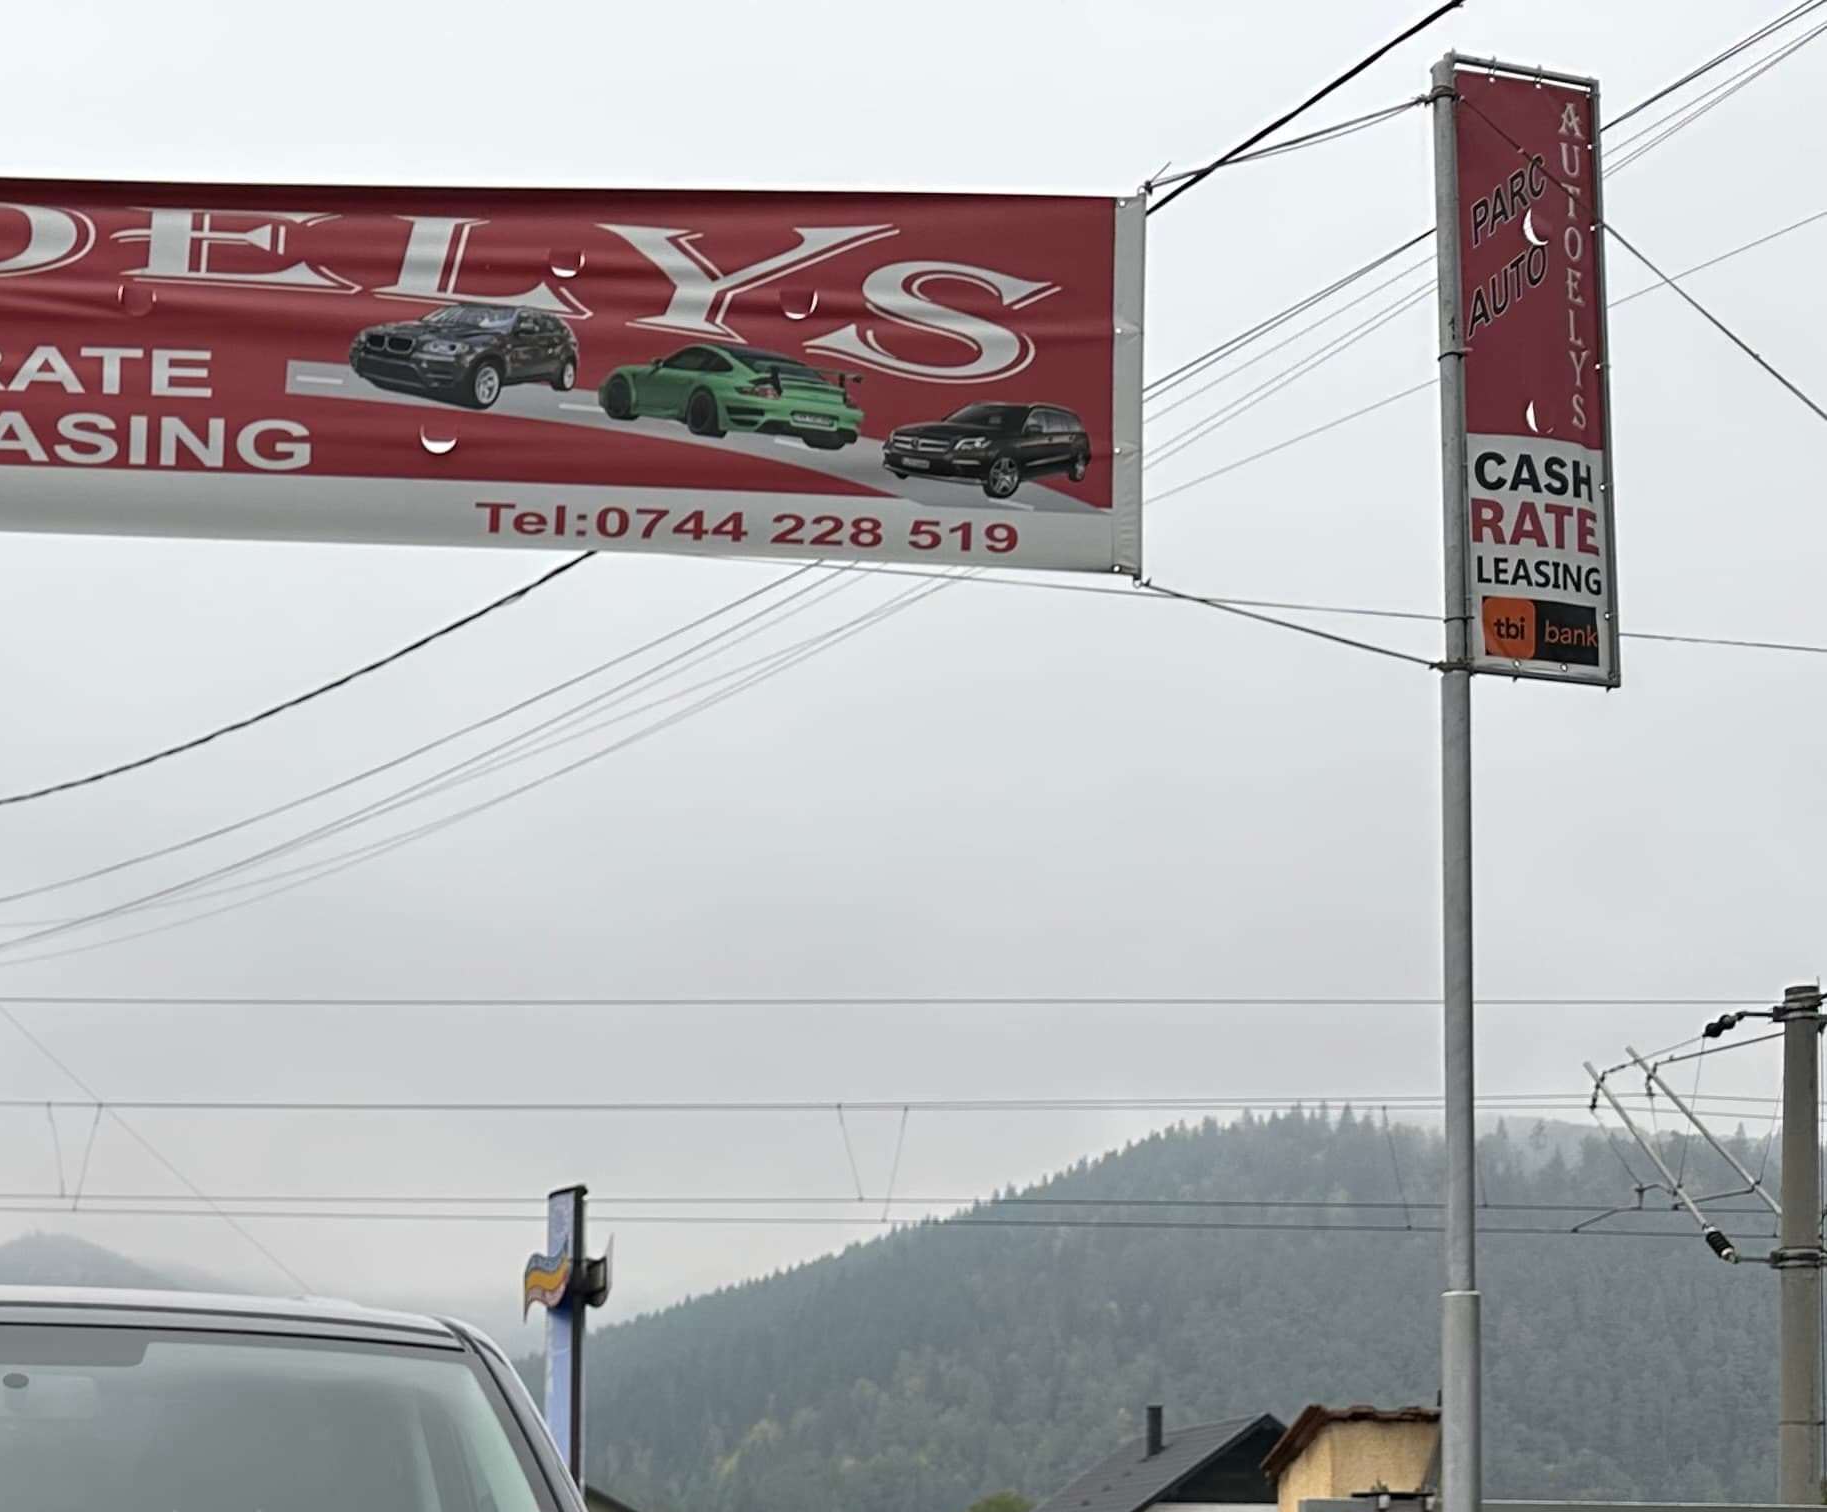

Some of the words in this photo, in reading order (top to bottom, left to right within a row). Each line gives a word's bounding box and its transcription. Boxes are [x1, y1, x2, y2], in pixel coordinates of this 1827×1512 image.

[1469, 154, 1548, 249] PARC
[1466, 242, 1549, 341] AUTO
[1556, 102, 1588, 431] AUTOELYS
[1474, 450, 1593, 503] CASH
[475, 501, 749, 543] Tel:0744
[771, 512, 884, 549] 228
[907, 521, 1020, 554] 519
[1471, 497, 1600, 557] RATE
[1476, 556, 1603, 597] LEASING
[1493, 604, 1526, 641] tbi
[1543, 617, 1598, 648] bank
